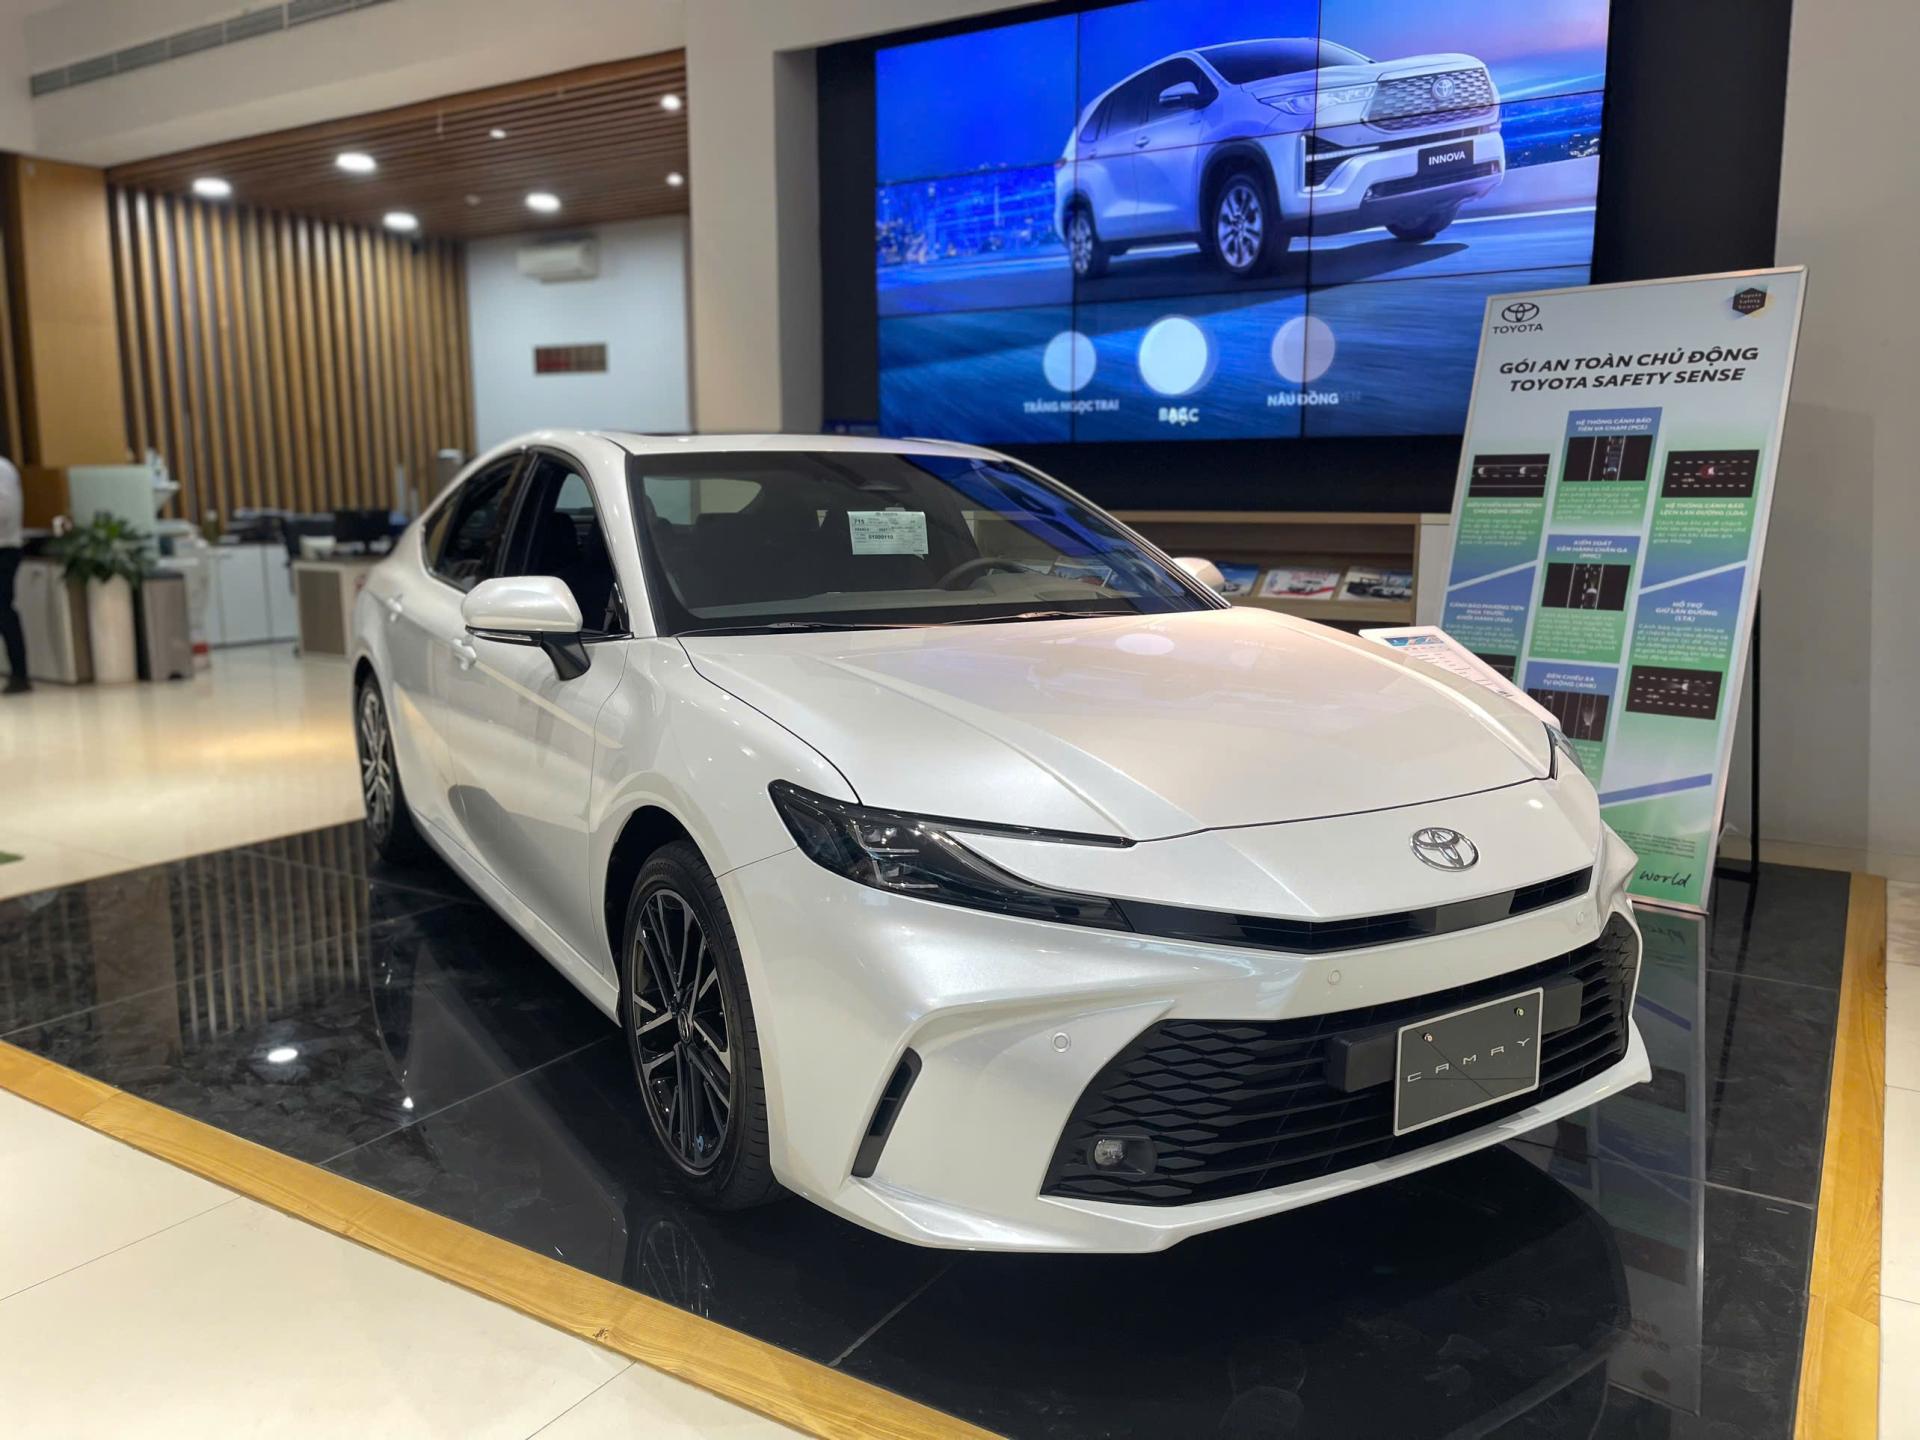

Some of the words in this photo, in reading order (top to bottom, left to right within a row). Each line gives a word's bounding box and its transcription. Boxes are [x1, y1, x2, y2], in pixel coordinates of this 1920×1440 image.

[1428, 150, 1466, 166] INNOVA
[1492, 323, 1544, 334] TOYOTA
[1500, 358, 1536, 374] GÓI
[1538, 359, 1570, 373] AN
[1574, 353, 1633, 370] TOÀN
[1636, 347, 1685, 366] CHỦ
[1687, 346, 1759, 366] ĐỘNG
[1510, 376, 1588, 392] TOYOTA
[1592, 371, 1672, 388] SAFETY
[1673, 367, 1746, 384] SENSE
[1639, 870, 1692, 888] world
[1407, 1037, 1531, 1082] CAMRY
